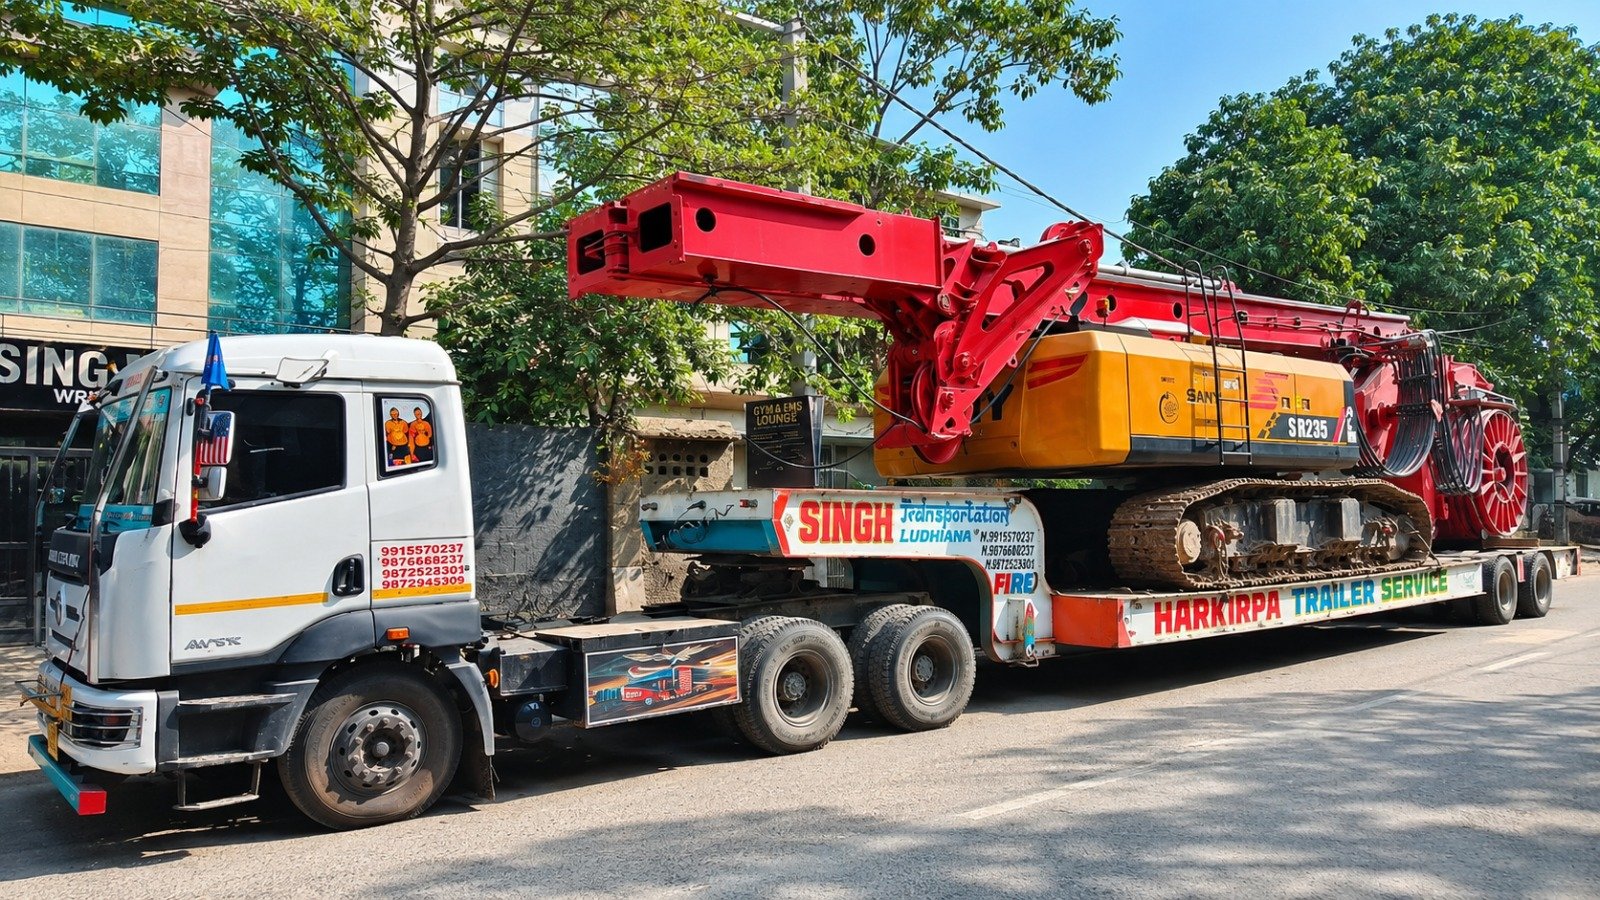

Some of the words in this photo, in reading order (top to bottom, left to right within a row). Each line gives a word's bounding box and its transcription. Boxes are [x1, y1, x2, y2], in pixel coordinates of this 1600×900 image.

[753, 404, 773, 416] GYM
[783, 401, 803, 412] EMS
[756, 412, 797, 426] LOUNGE
[1288, 417, 1338, 439] SR235
[798, 499, 894, 544] SINGH
[899, 497, 1010, 529] Transportation
[899, 529, 972, 543] LUDHIANA
[381, 543, 464, 557] 9915570237
[382, 575, 465, 589] 9872945309
[1154, 590, 1281, 635] HARKIRPA
[1291, 580, 1375, 615] TRAILER
[1381, 570, 1448, 601] SERVICE
